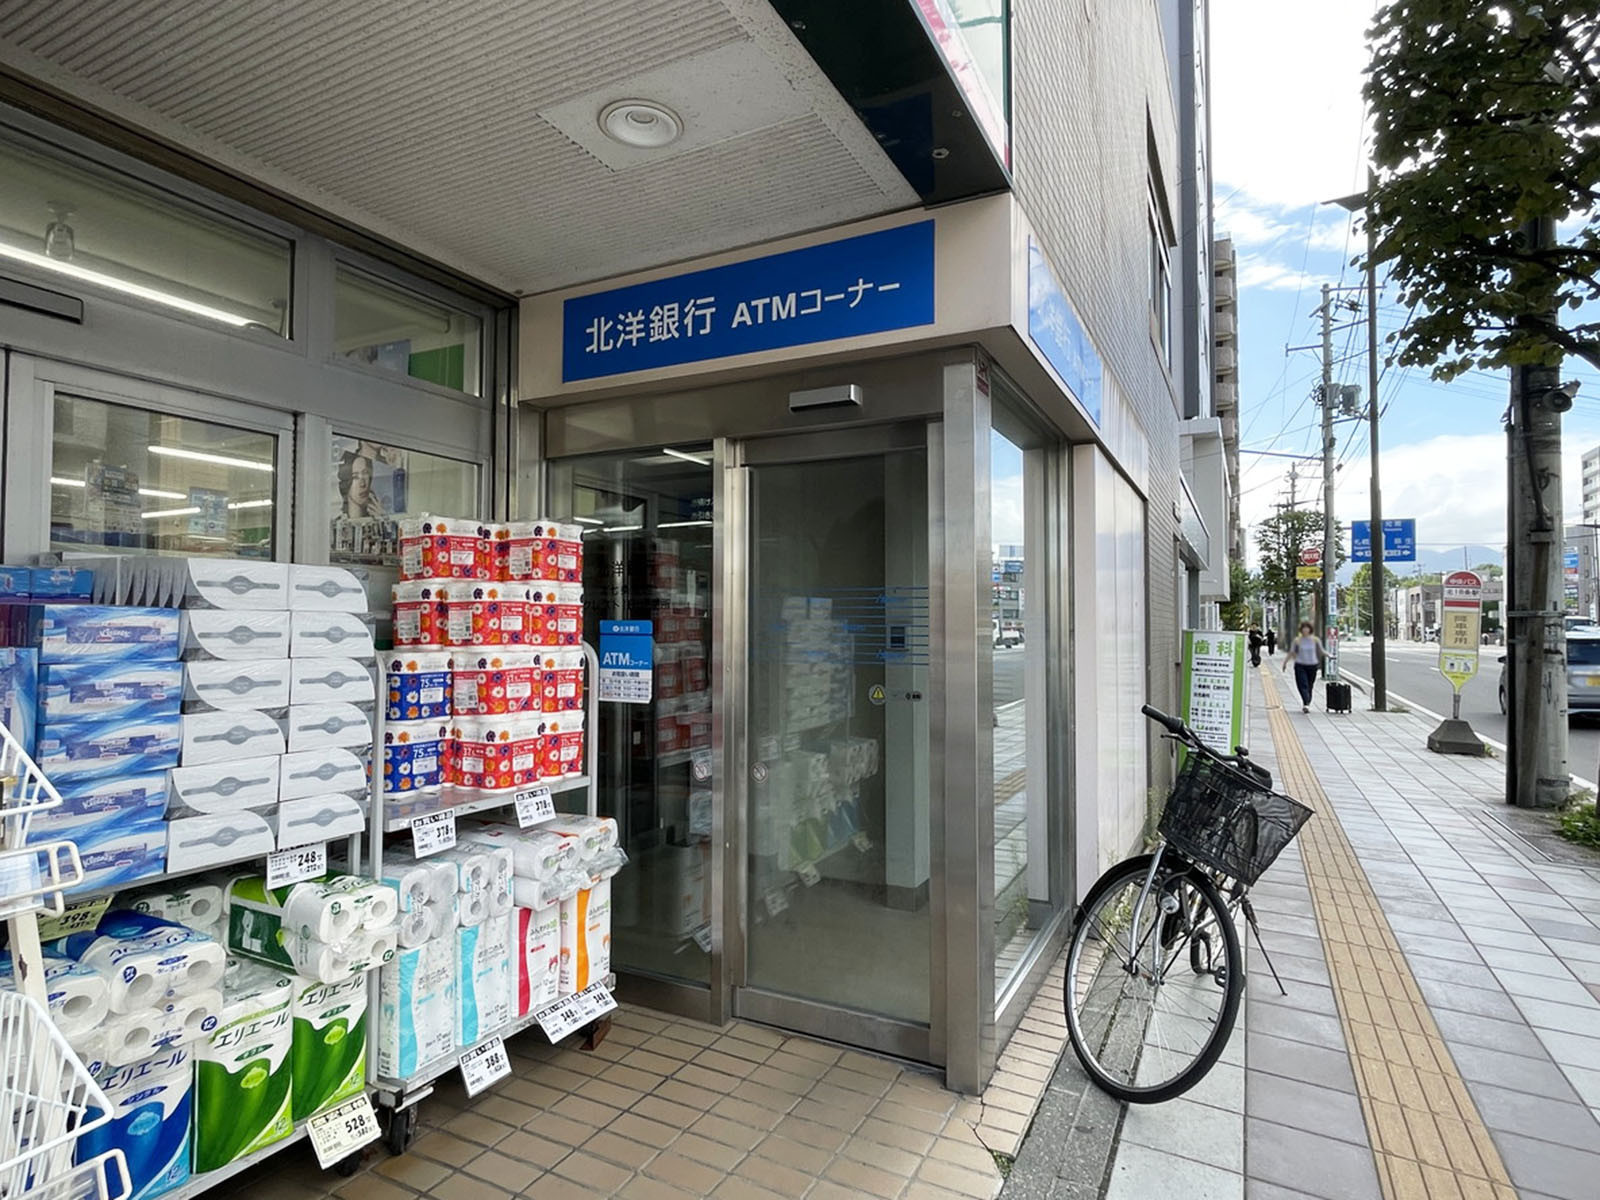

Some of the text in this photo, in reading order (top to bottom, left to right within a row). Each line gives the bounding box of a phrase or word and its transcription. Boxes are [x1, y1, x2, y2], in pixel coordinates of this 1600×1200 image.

[585, 277, 901, 354] 北洋銀行 ATMコーナー
[1194, 639, 1234, 657] 歯科
[297, 850, 317, 868] 248
[60, 910, 91, 926] 398
[302, 975, 364, 1007] エリエール
[203, 1016, 216, 1030] 12
[213, 1011, 290, 1049] エリエール
[101, 1050, 188, 1091] エリエール
[344, 1114, 366, 1133] 528
